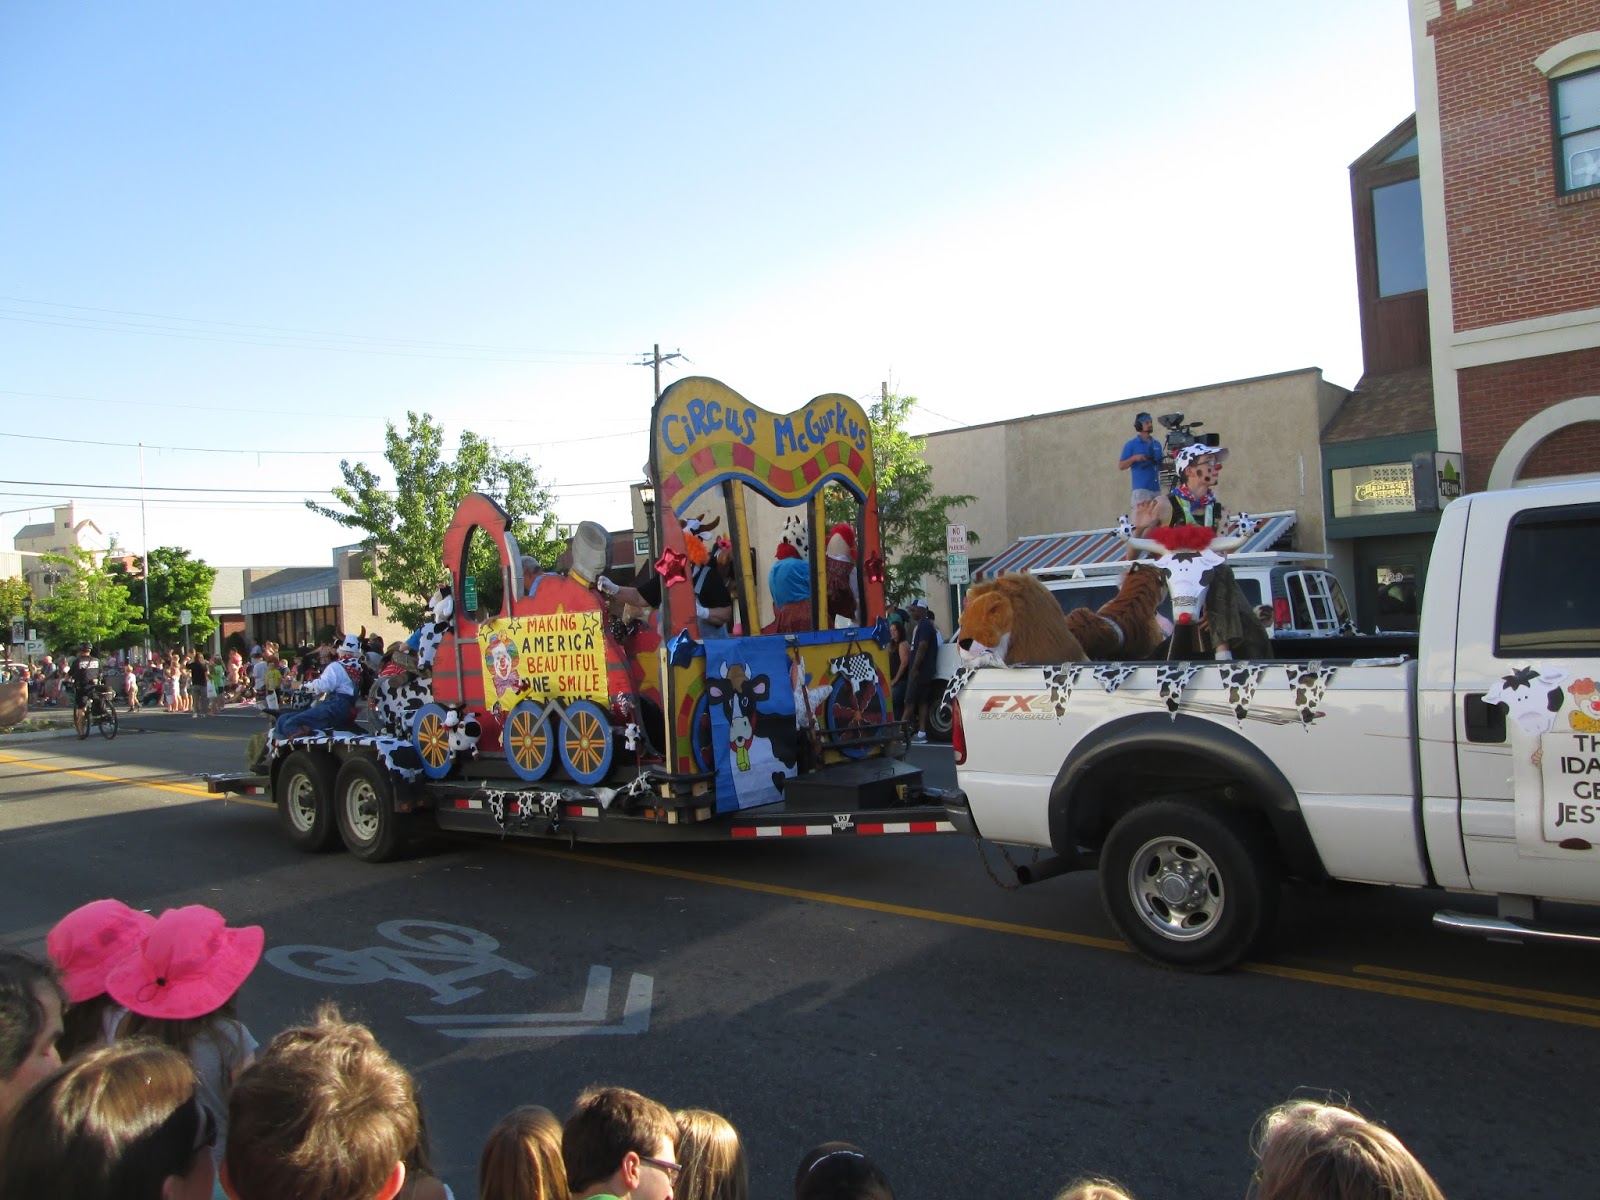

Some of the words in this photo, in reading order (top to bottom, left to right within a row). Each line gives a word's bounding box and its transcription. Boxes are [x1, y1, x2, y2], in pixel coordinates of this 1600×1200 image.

[774, 402, 867, 456] McGurkus
[952, 527, 961, 535] NO
[527, 614, 577, 633] MAKING
[522, 634, 594, 653] AMERICA
[527, 654, 598, 673] BEAUTIFUL
[558, 674, 600, 692] SMILE
[981, 695, 1053, 712] FX4
[1561, 757, 1600, 774] IDA
